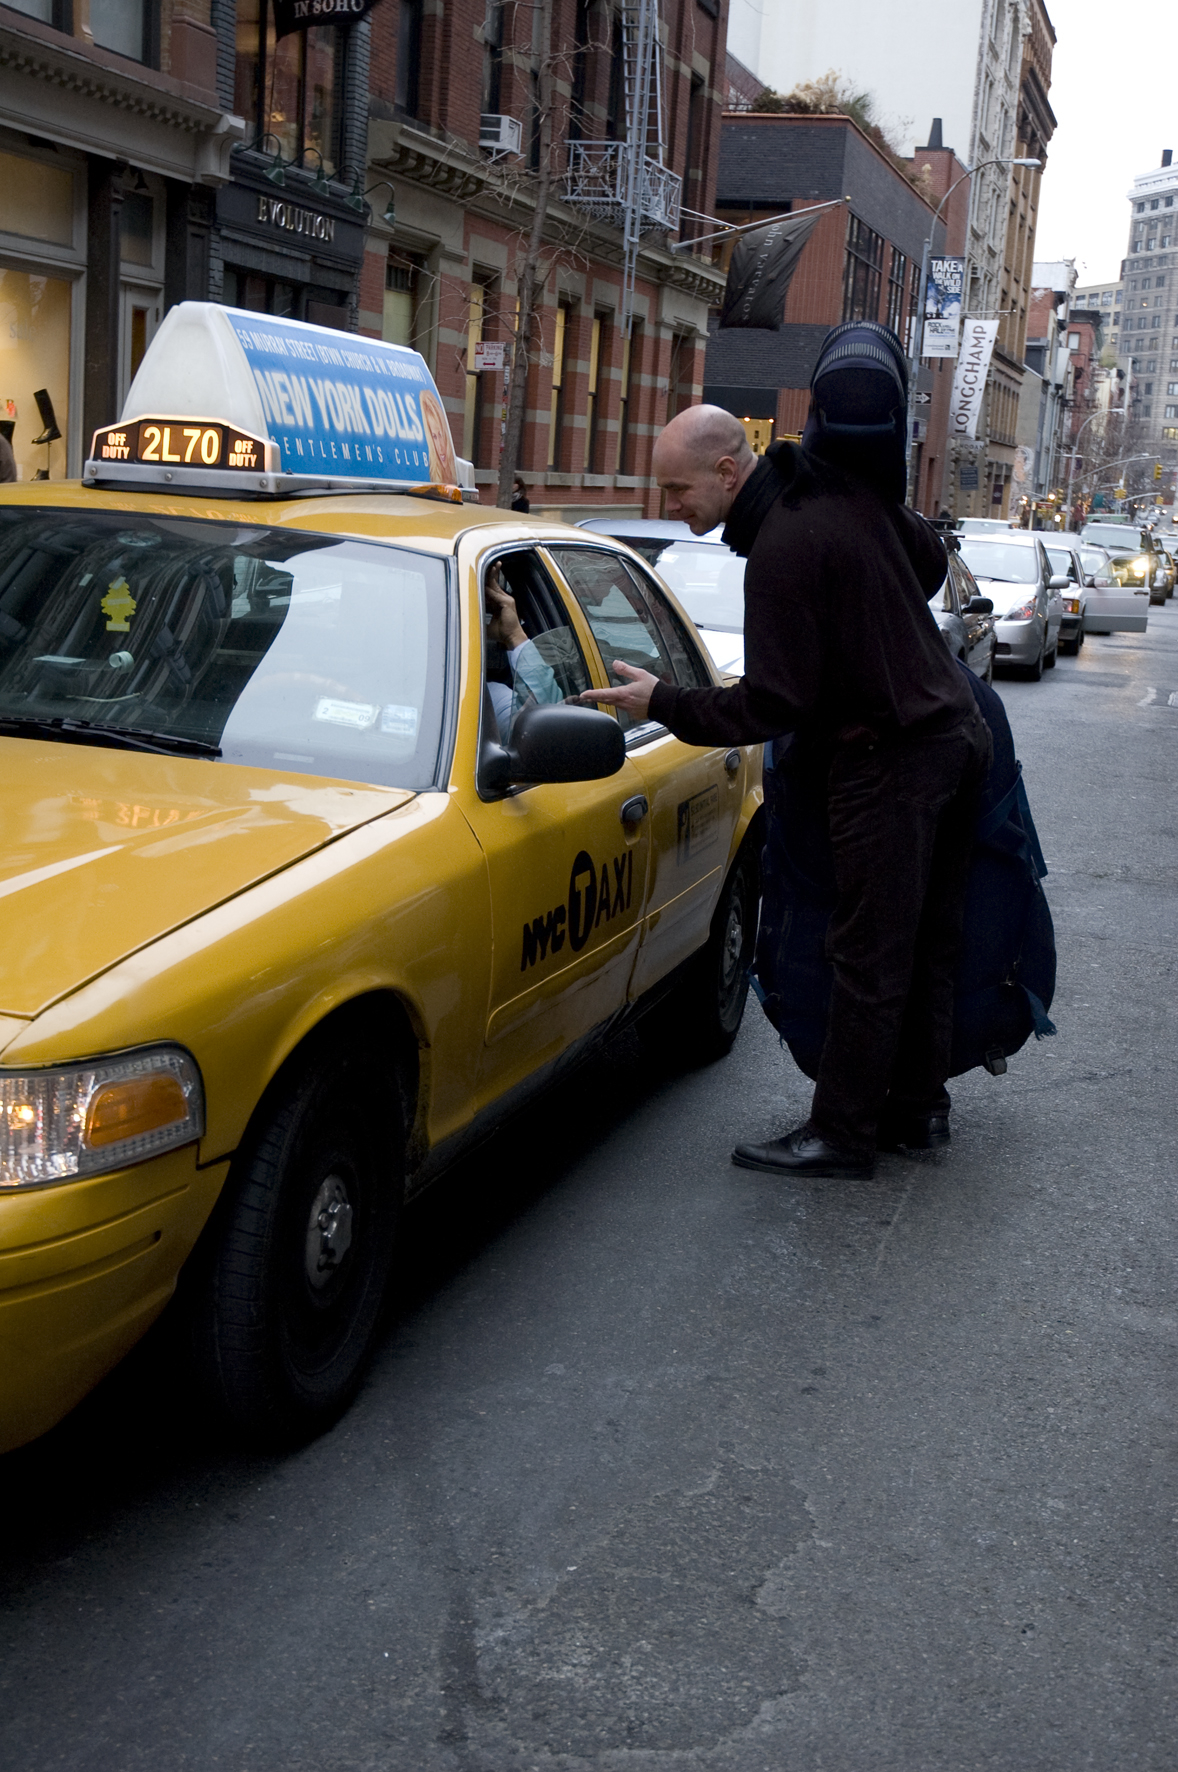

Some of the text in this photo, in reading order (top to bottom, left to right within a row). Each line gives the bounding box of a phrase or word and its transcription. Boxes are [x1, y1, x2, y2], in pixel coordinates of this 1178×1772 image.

[294, 0, 364, 18] IN SOHO
[257, 196, 335, 242] EVOLUTION
[931, 260, 964, 272] TAKE A
[933, 272, 951, 280] WALK
[943, 279, 961, 287] WILD
[947, 286, 961, 294] SIDE
[236, 328, 254, 350] 59
[249, 331, 289, 356] MURRAY
[285, 338, 319, 362] STREET
[340, 349, 374, 372] CHURCH
[955, 325, 987, 434] LONGCHAMP
[253, 370, 423, 440] NEW YORK DOLLS
[107, 432, 127, 446] OFF
[142, 426, 219, 465] 2L70
[234, 440, 254, 453] OFF
[102, 445, 130, 460] DUTY
[229, 453, 257, 467] DUTY
[395, 448, 429, 467] CLUB
[521, 850, 633, 972] NYC TAXI
